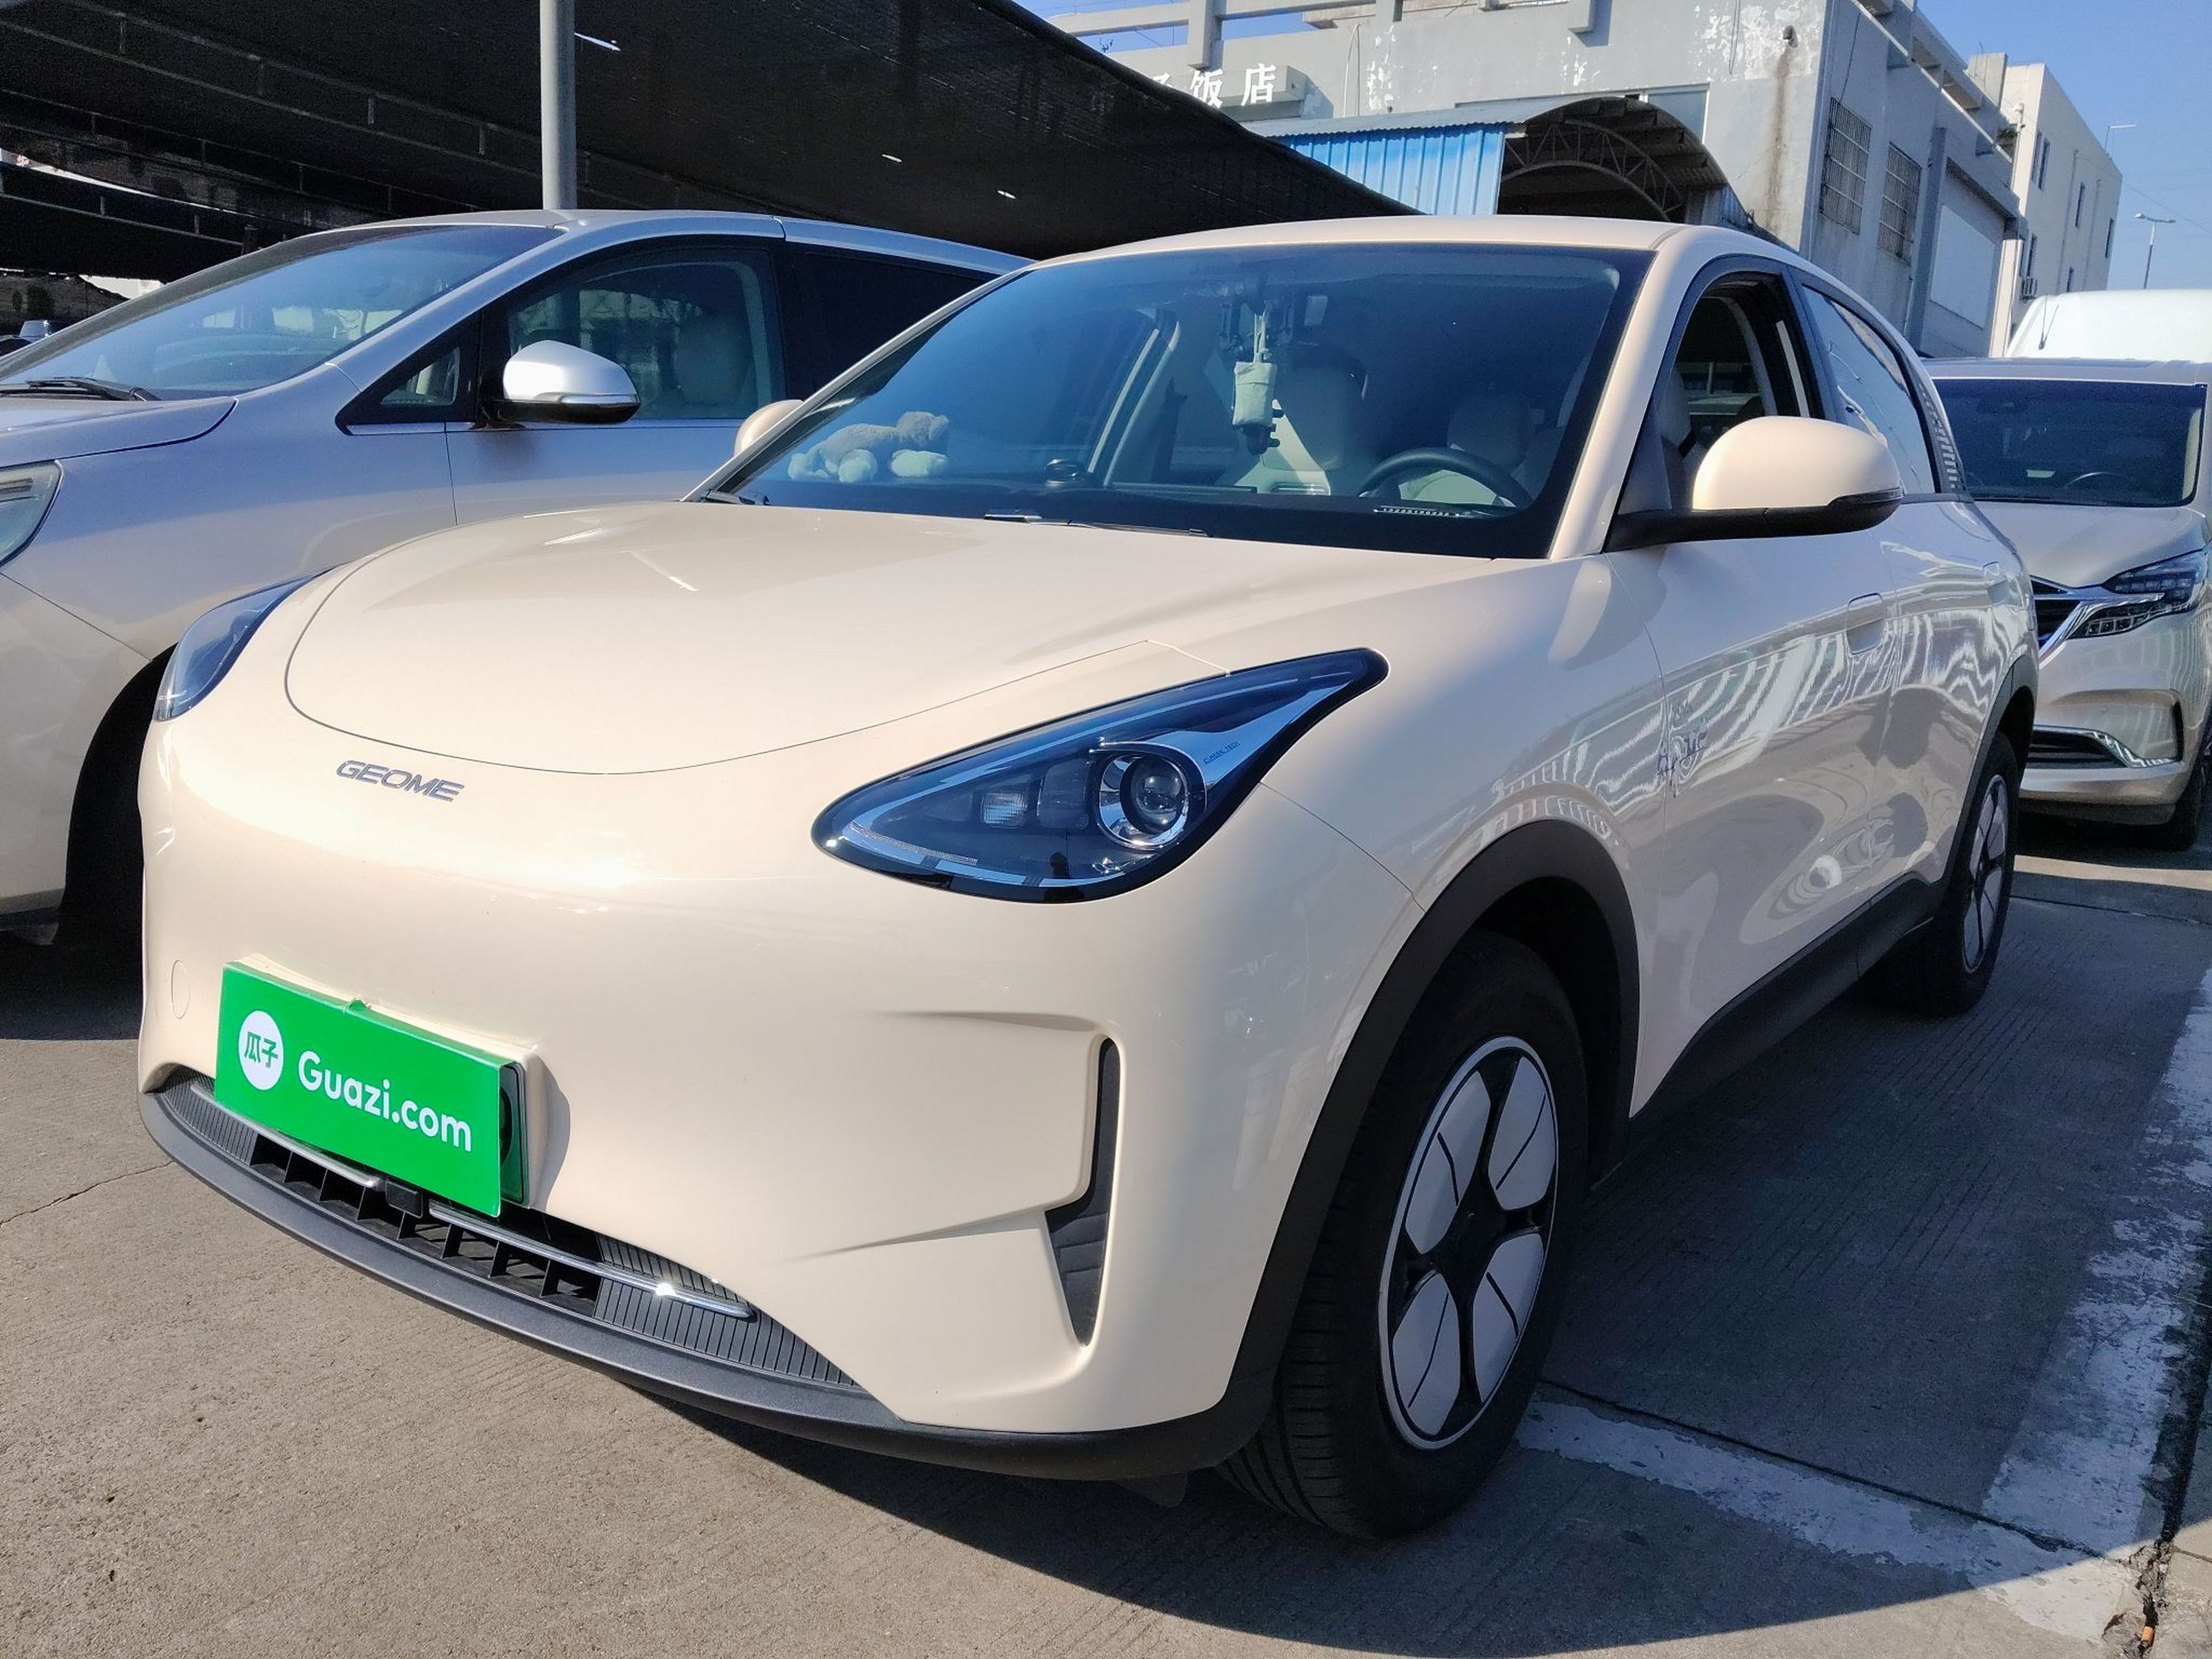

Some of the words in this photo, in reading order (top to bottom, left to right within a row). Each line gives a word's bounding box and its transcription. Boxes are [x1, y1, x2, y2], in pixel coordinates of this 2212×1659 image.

[336, 760, 465, 802] GEOME
[244, 1031, 278, 1069] 瓜子
[298, 1051, 472, 1152] Guazi.com
